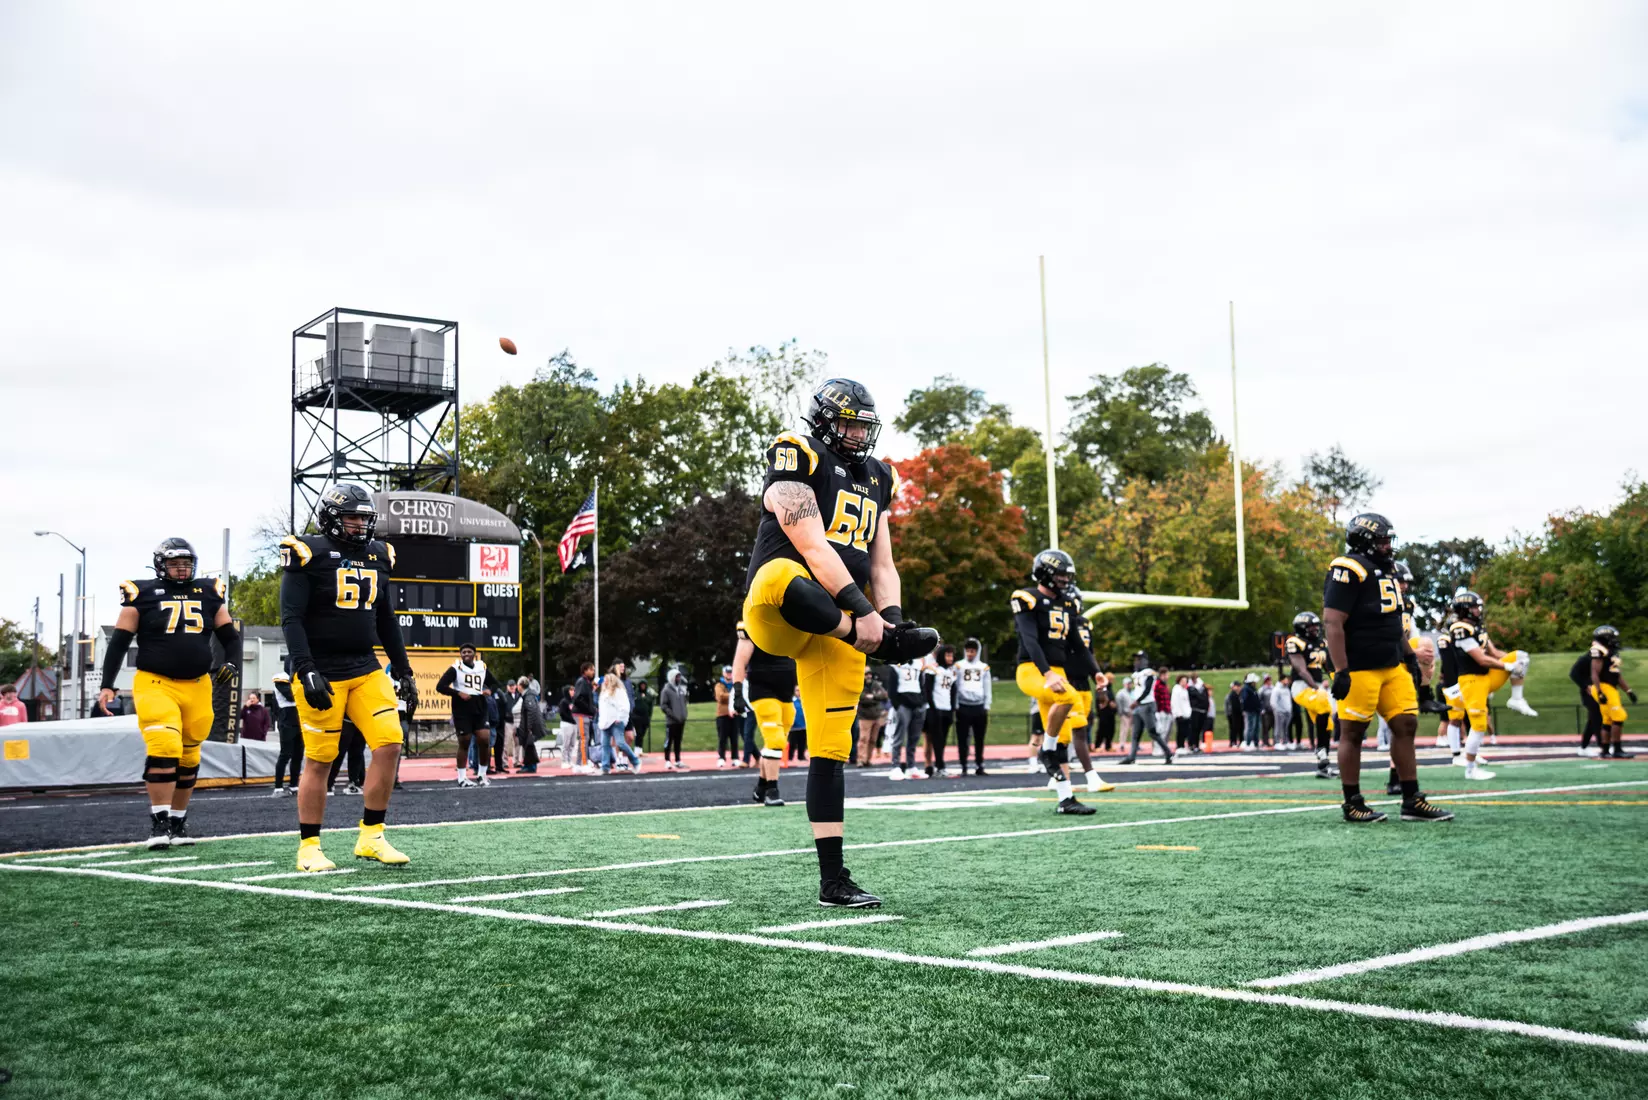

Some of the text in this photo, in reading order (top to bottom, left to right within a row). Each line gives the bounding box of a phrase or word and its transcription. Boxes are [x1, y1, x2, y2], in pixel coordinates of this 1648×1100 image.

[774, 447, 798, 471] 60
[852, 483, 869, 496] VILLE
[389, 500, 454, 519] CHRYST
[400, 518, 449, 536] FIELD
[460, 517, 508, 528] UNIVERSITY
[823, 489, 878, 553] 60
[1354, 517, 1379, 533] VILLE
[336, 568, 378, 610] 67
[483, 583, 520, 597] GUEST
[160, 600, 204, 634] 75
[399, 615, 488, 628] GO BALL ON QTR
[1048, 610, 1069, 640] 51
[492, 635, 516, 648] T.O.L.
[1275, 634, 1285, 657] 4
[464, 674, 482, 692] 99
[963, 668, 982, 682] 83
